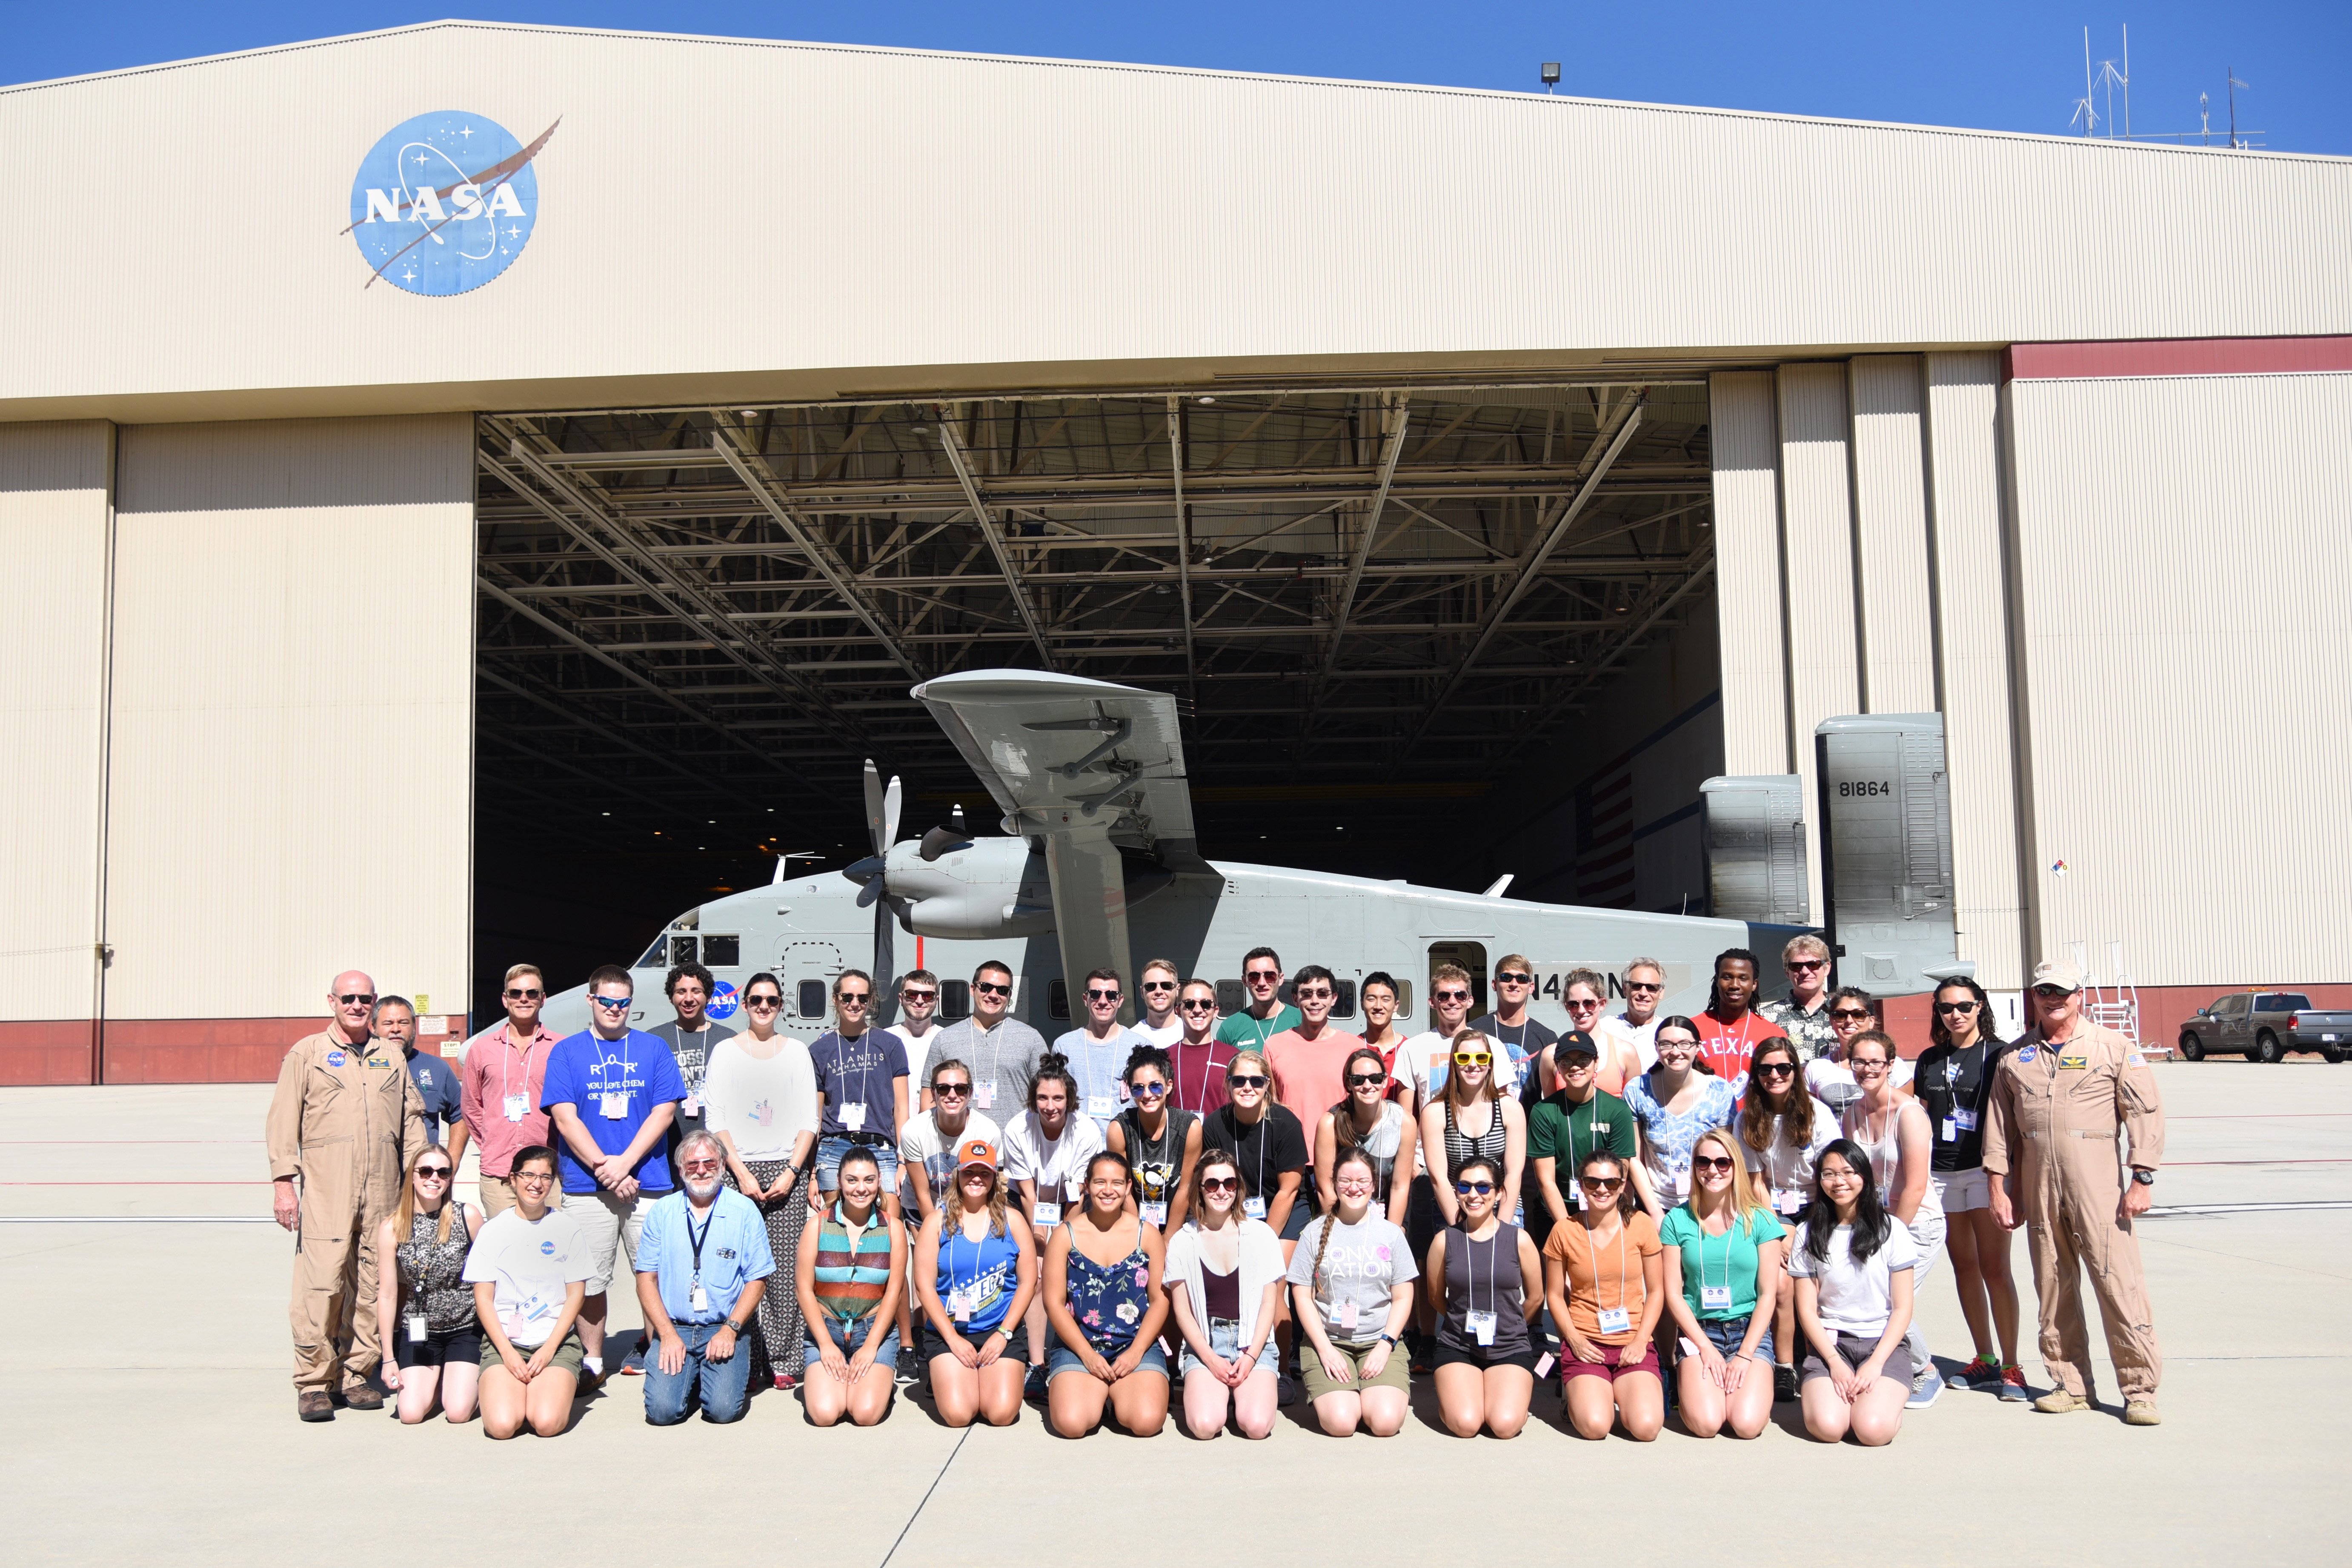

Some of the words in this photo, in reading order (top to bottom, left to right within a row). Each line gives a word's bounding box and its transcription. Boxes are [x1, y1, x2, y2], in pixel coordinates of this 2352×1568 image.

[365, 183, 526, 223] NASA
[1840, 781, 1889, 796] 81864
[674, 1052, 705, 1067] OSS
[832, 1062, 877, 1073] BAHAMAS
[586, 1082, 603, 1090] YOU
[996, 1260, 1007, 1270] 2016
